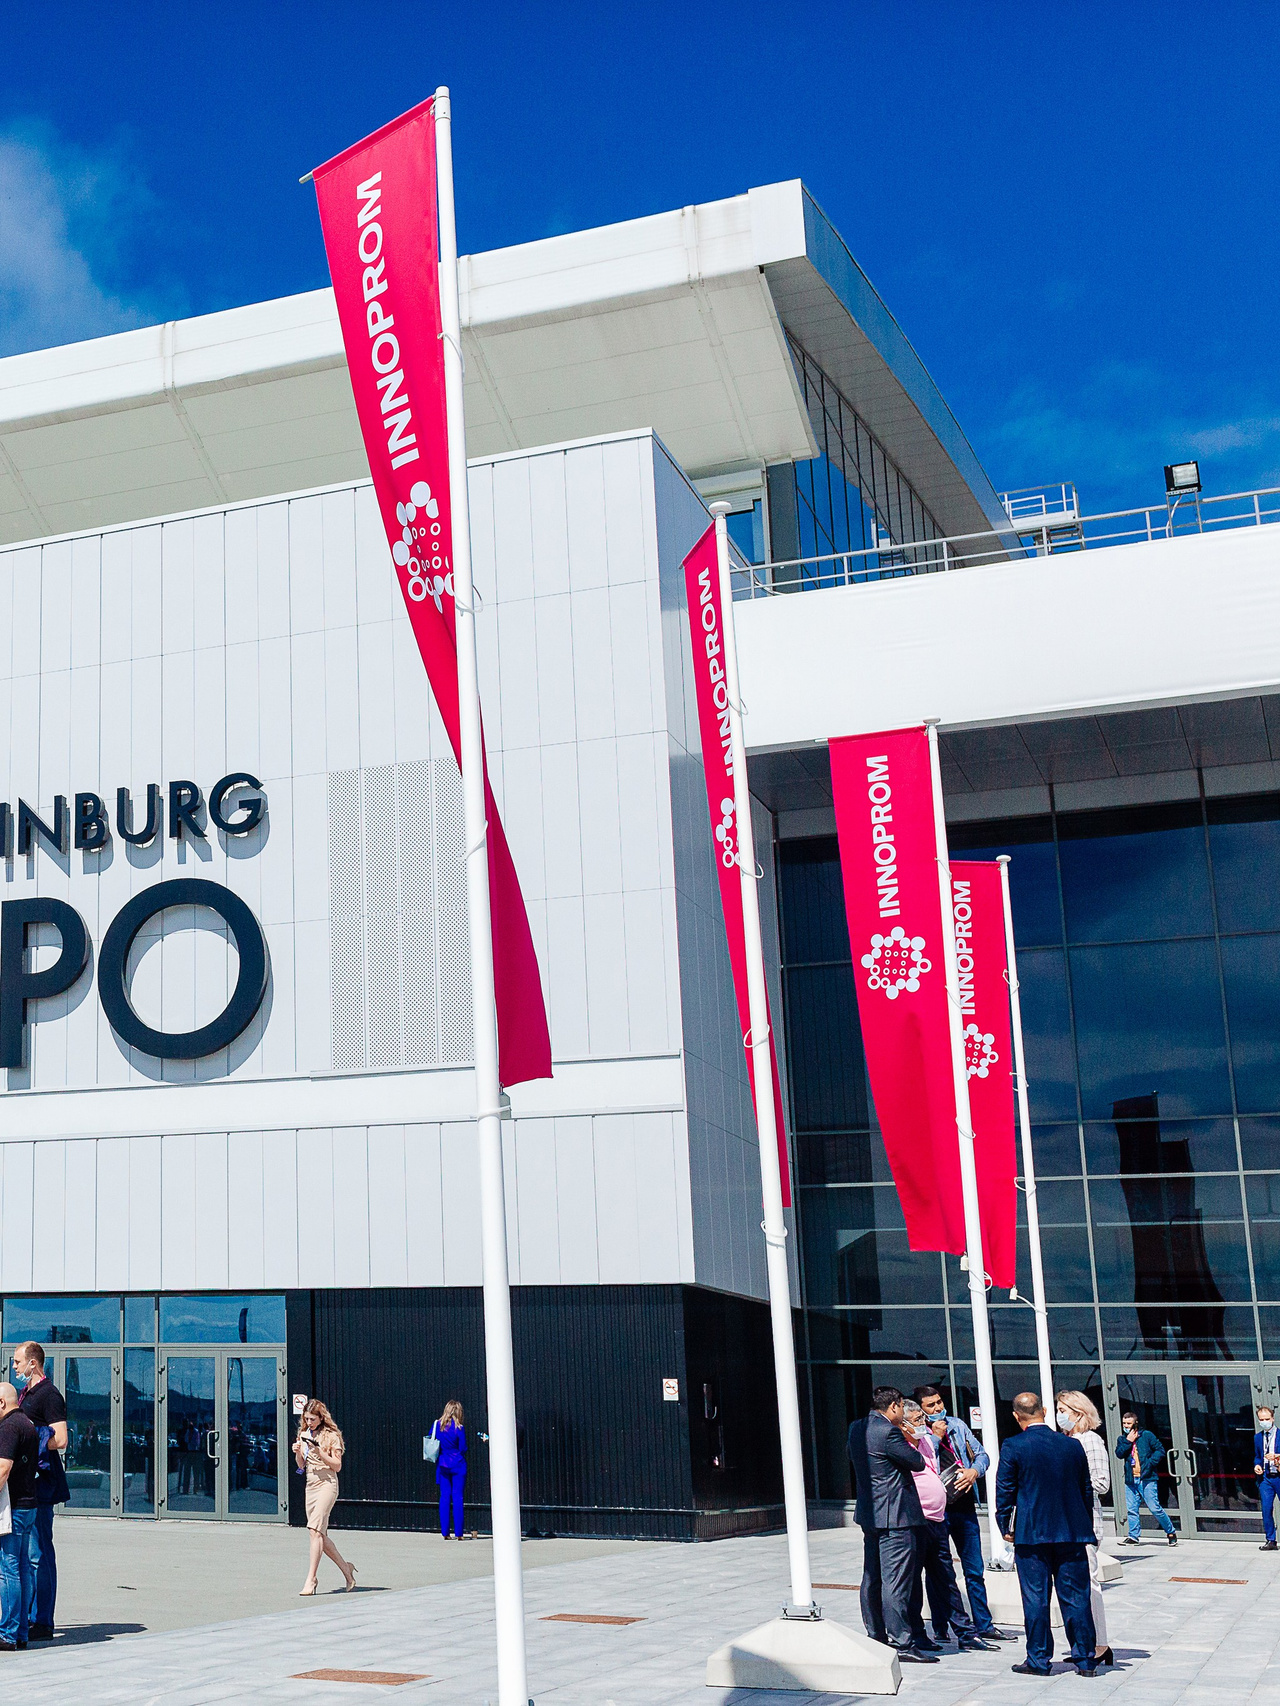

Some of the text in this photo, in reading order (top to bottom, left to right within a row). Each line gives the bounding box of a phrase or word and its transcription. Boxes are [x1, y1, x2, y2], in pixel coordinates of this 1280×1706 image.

[356, 170, 420, 471] INNOPROM
[866, 755, 901, 918] INNOPROM
[953, 881, 976, 1015] INNOPROM
